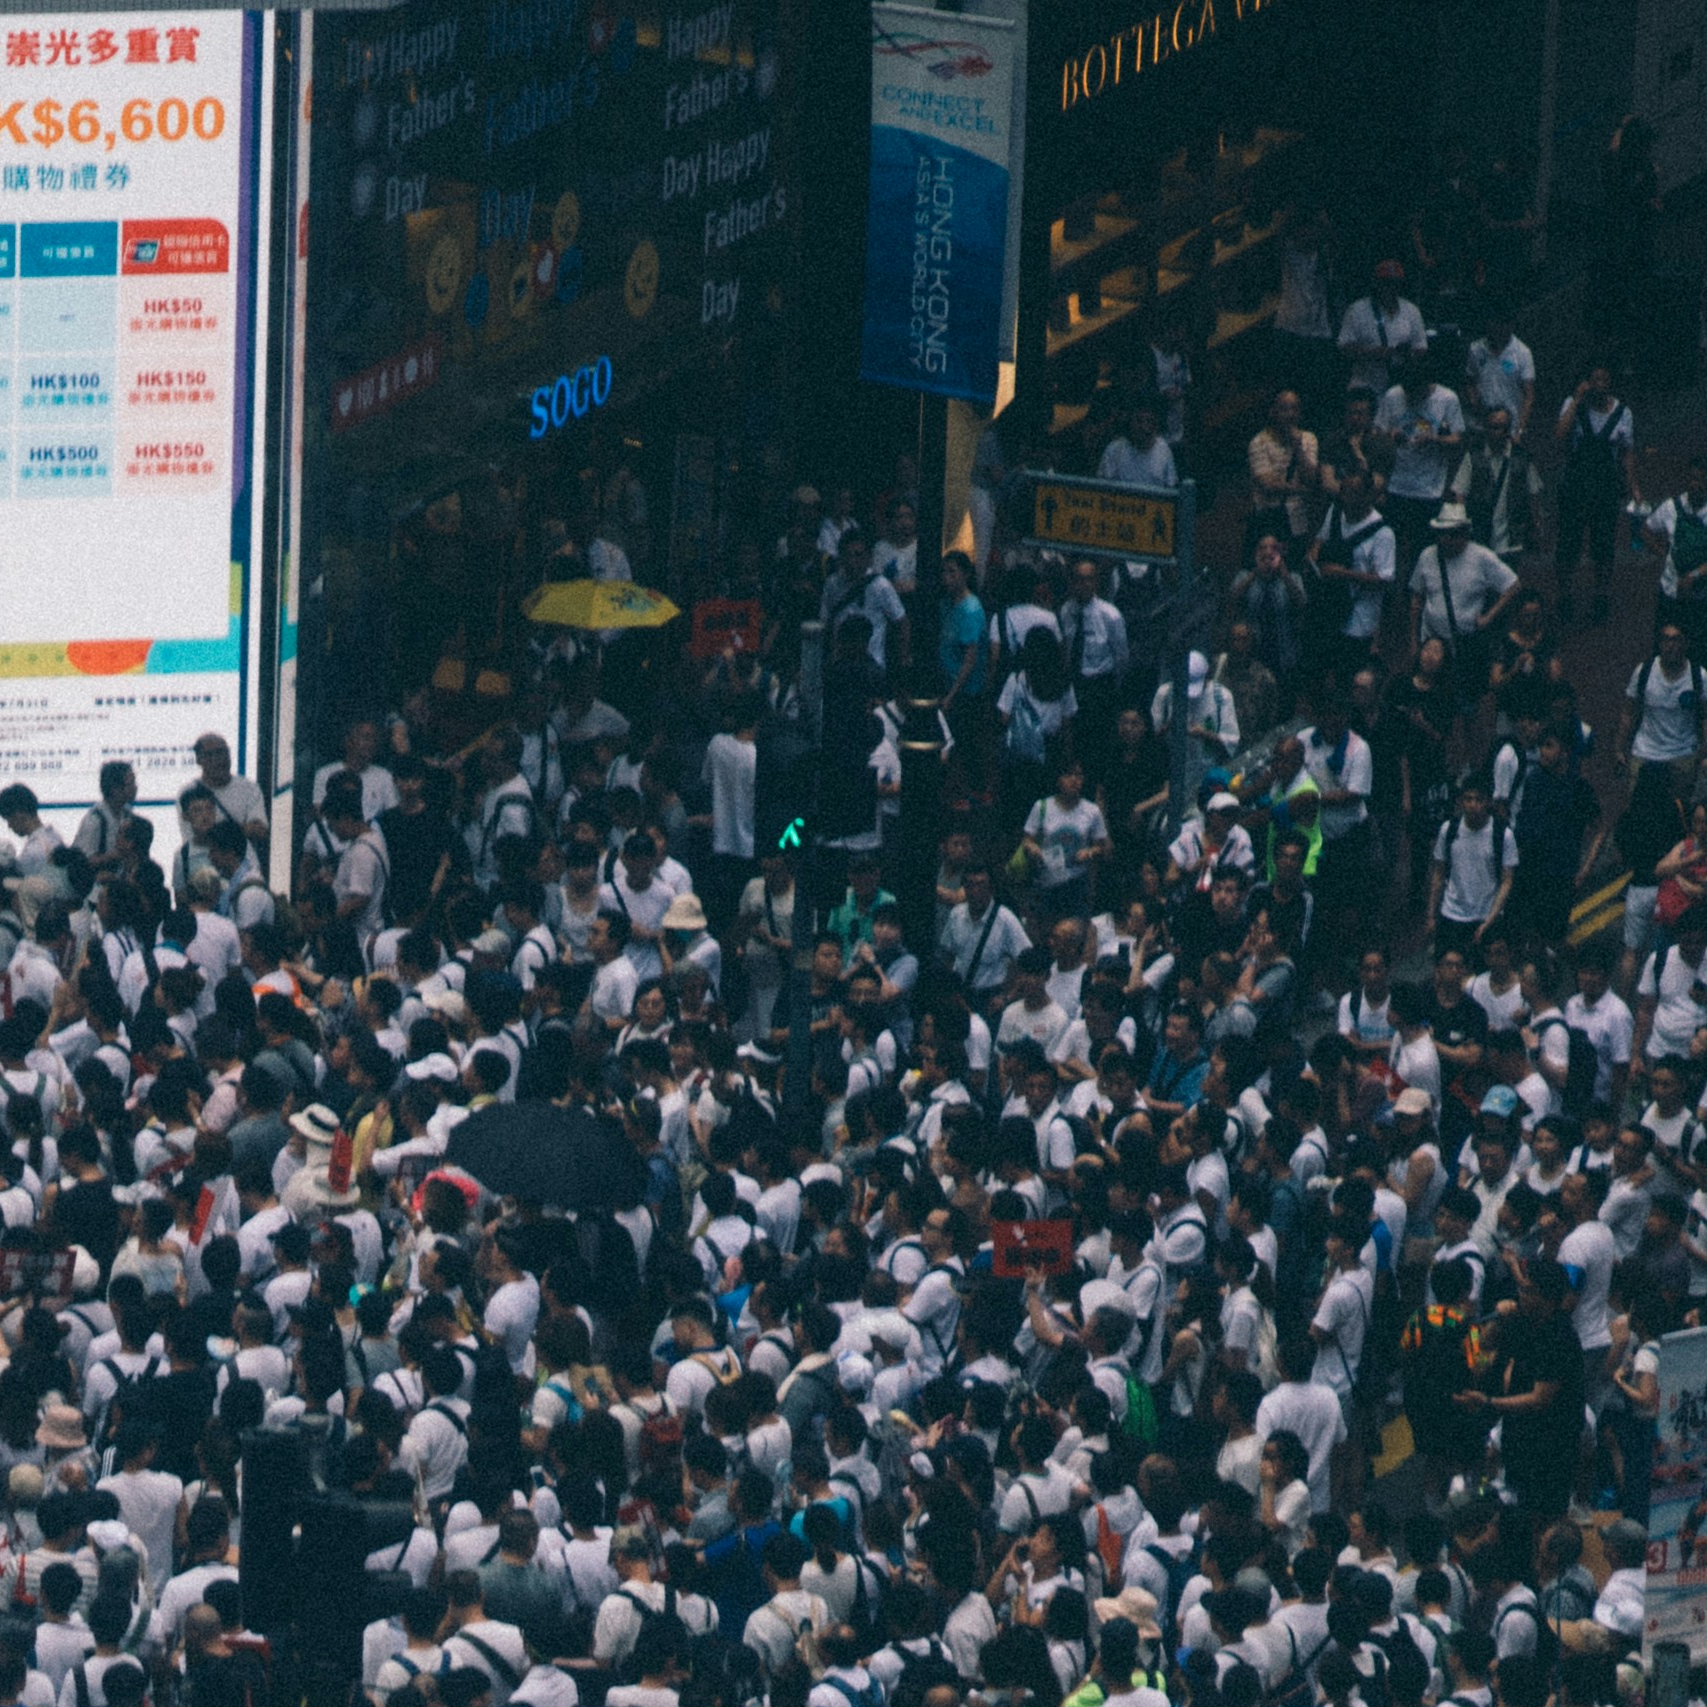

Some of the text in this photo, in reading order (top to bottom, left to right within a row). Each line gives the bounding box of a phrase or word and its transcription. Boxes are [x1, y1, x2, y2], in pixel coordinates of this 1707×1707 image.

[6, 27, 201, 66] 崇光多重賞
[1061, 0, 1217, 112] BOTTEGA
[387, 72, 476, 147] Father's
[664, 66, 750, 130] Father's
[881, 84, 986, 113] CONNECT
[1, 162, 132, 191] 購物禮券
[662, 128, 771, 200] Day Happy
[702, 181, 787, 255] Father's
[923, 156, 955, 374] HONG KONG
[144, 298, 203, 313] HK$50
[699, 277, 742, 325] Day
[31, 373, 100, 390] HK$100
[137, 371, 206, 387] HK$150
[528, 353, 614, 440] SOGO
[29, 446, 99, 461] HK$500
